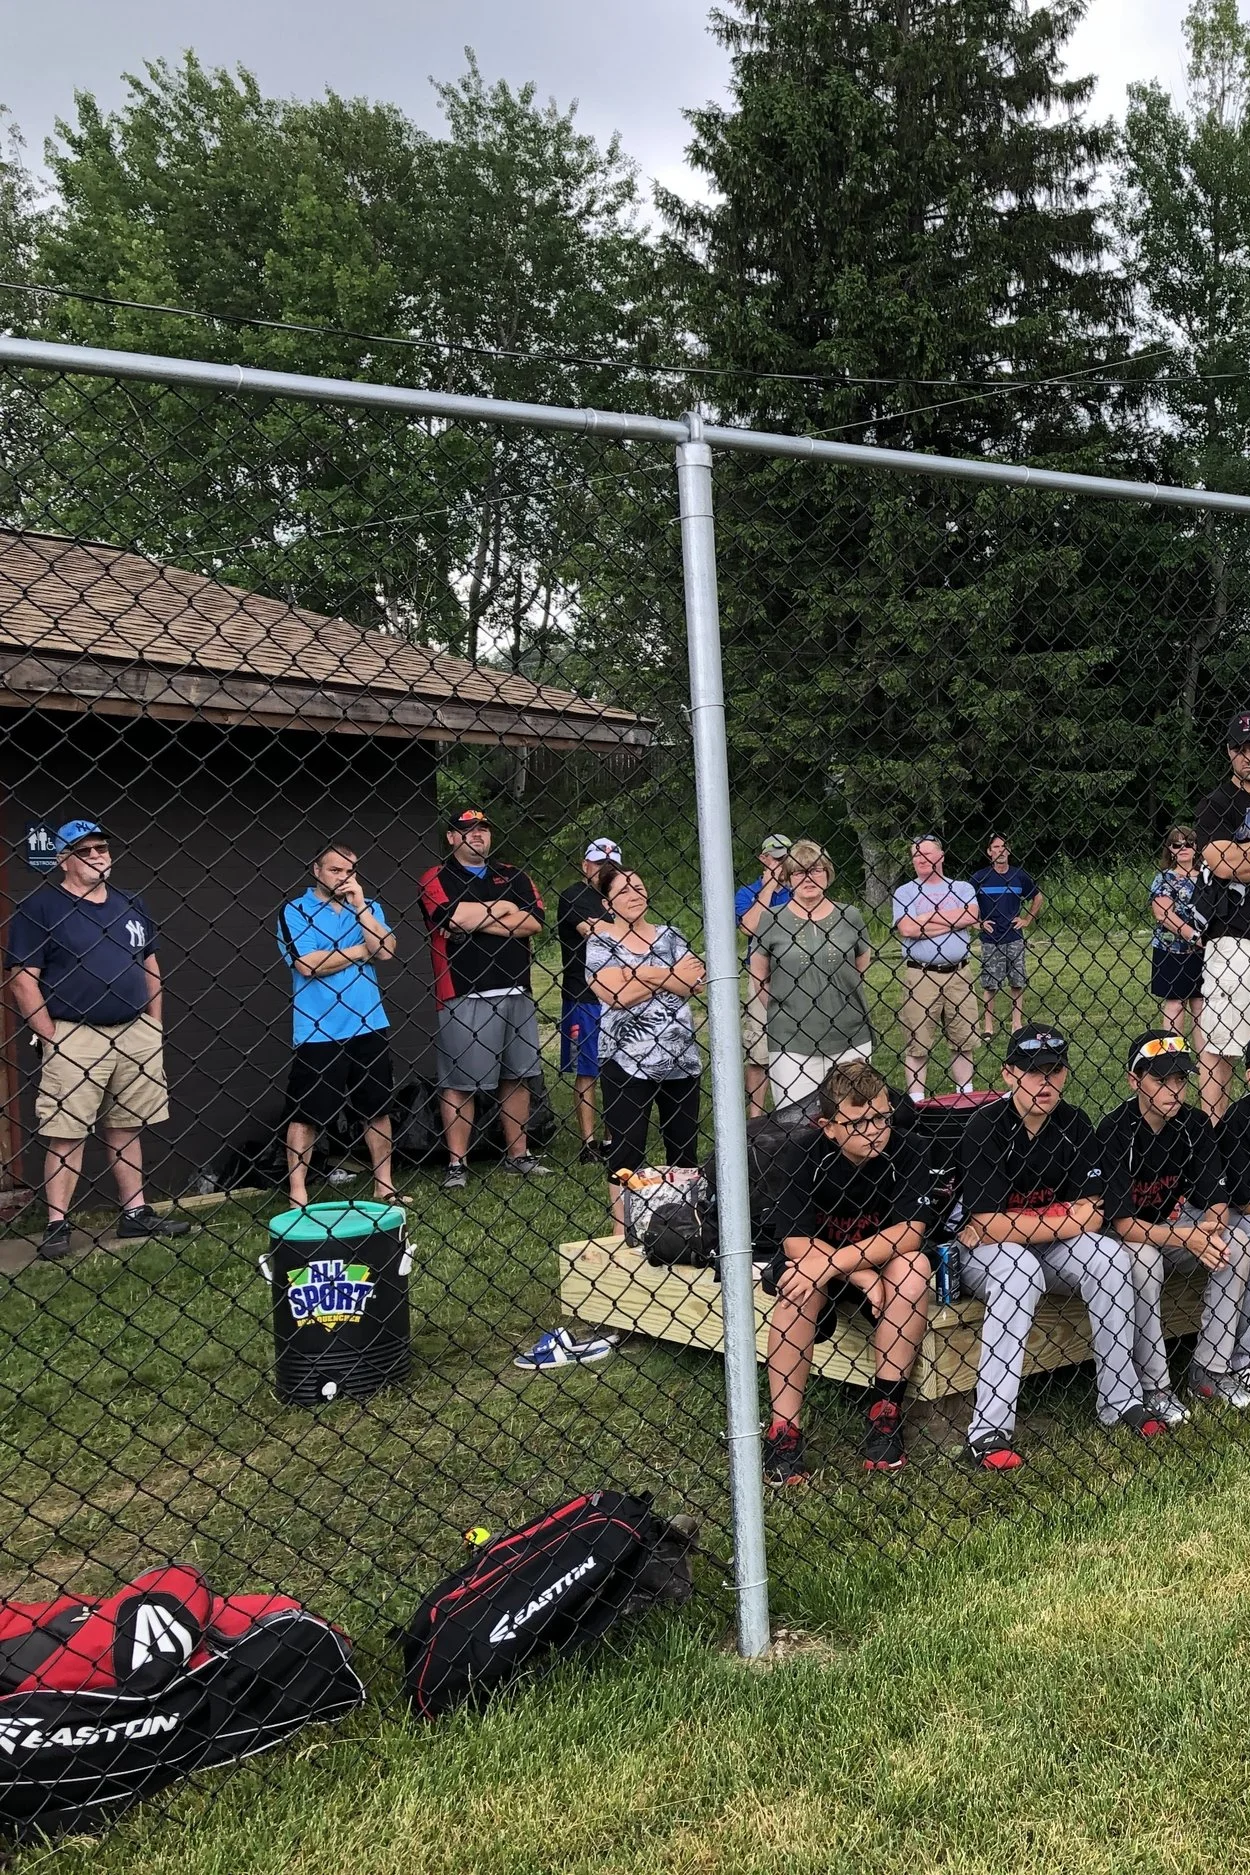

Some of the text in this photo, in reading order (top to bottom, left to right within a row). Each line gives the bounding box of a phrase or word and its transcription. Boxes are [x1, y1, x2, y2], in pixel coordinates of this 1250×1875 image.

[125, 919, 146, 948] NY
[310, 1261, 347, 1283] ALL
[289, 1282, 374, 1317] SPORT
[512, 1556, 597, 1630] EASTON
[20, 1712, 180, 1749] EASTON
